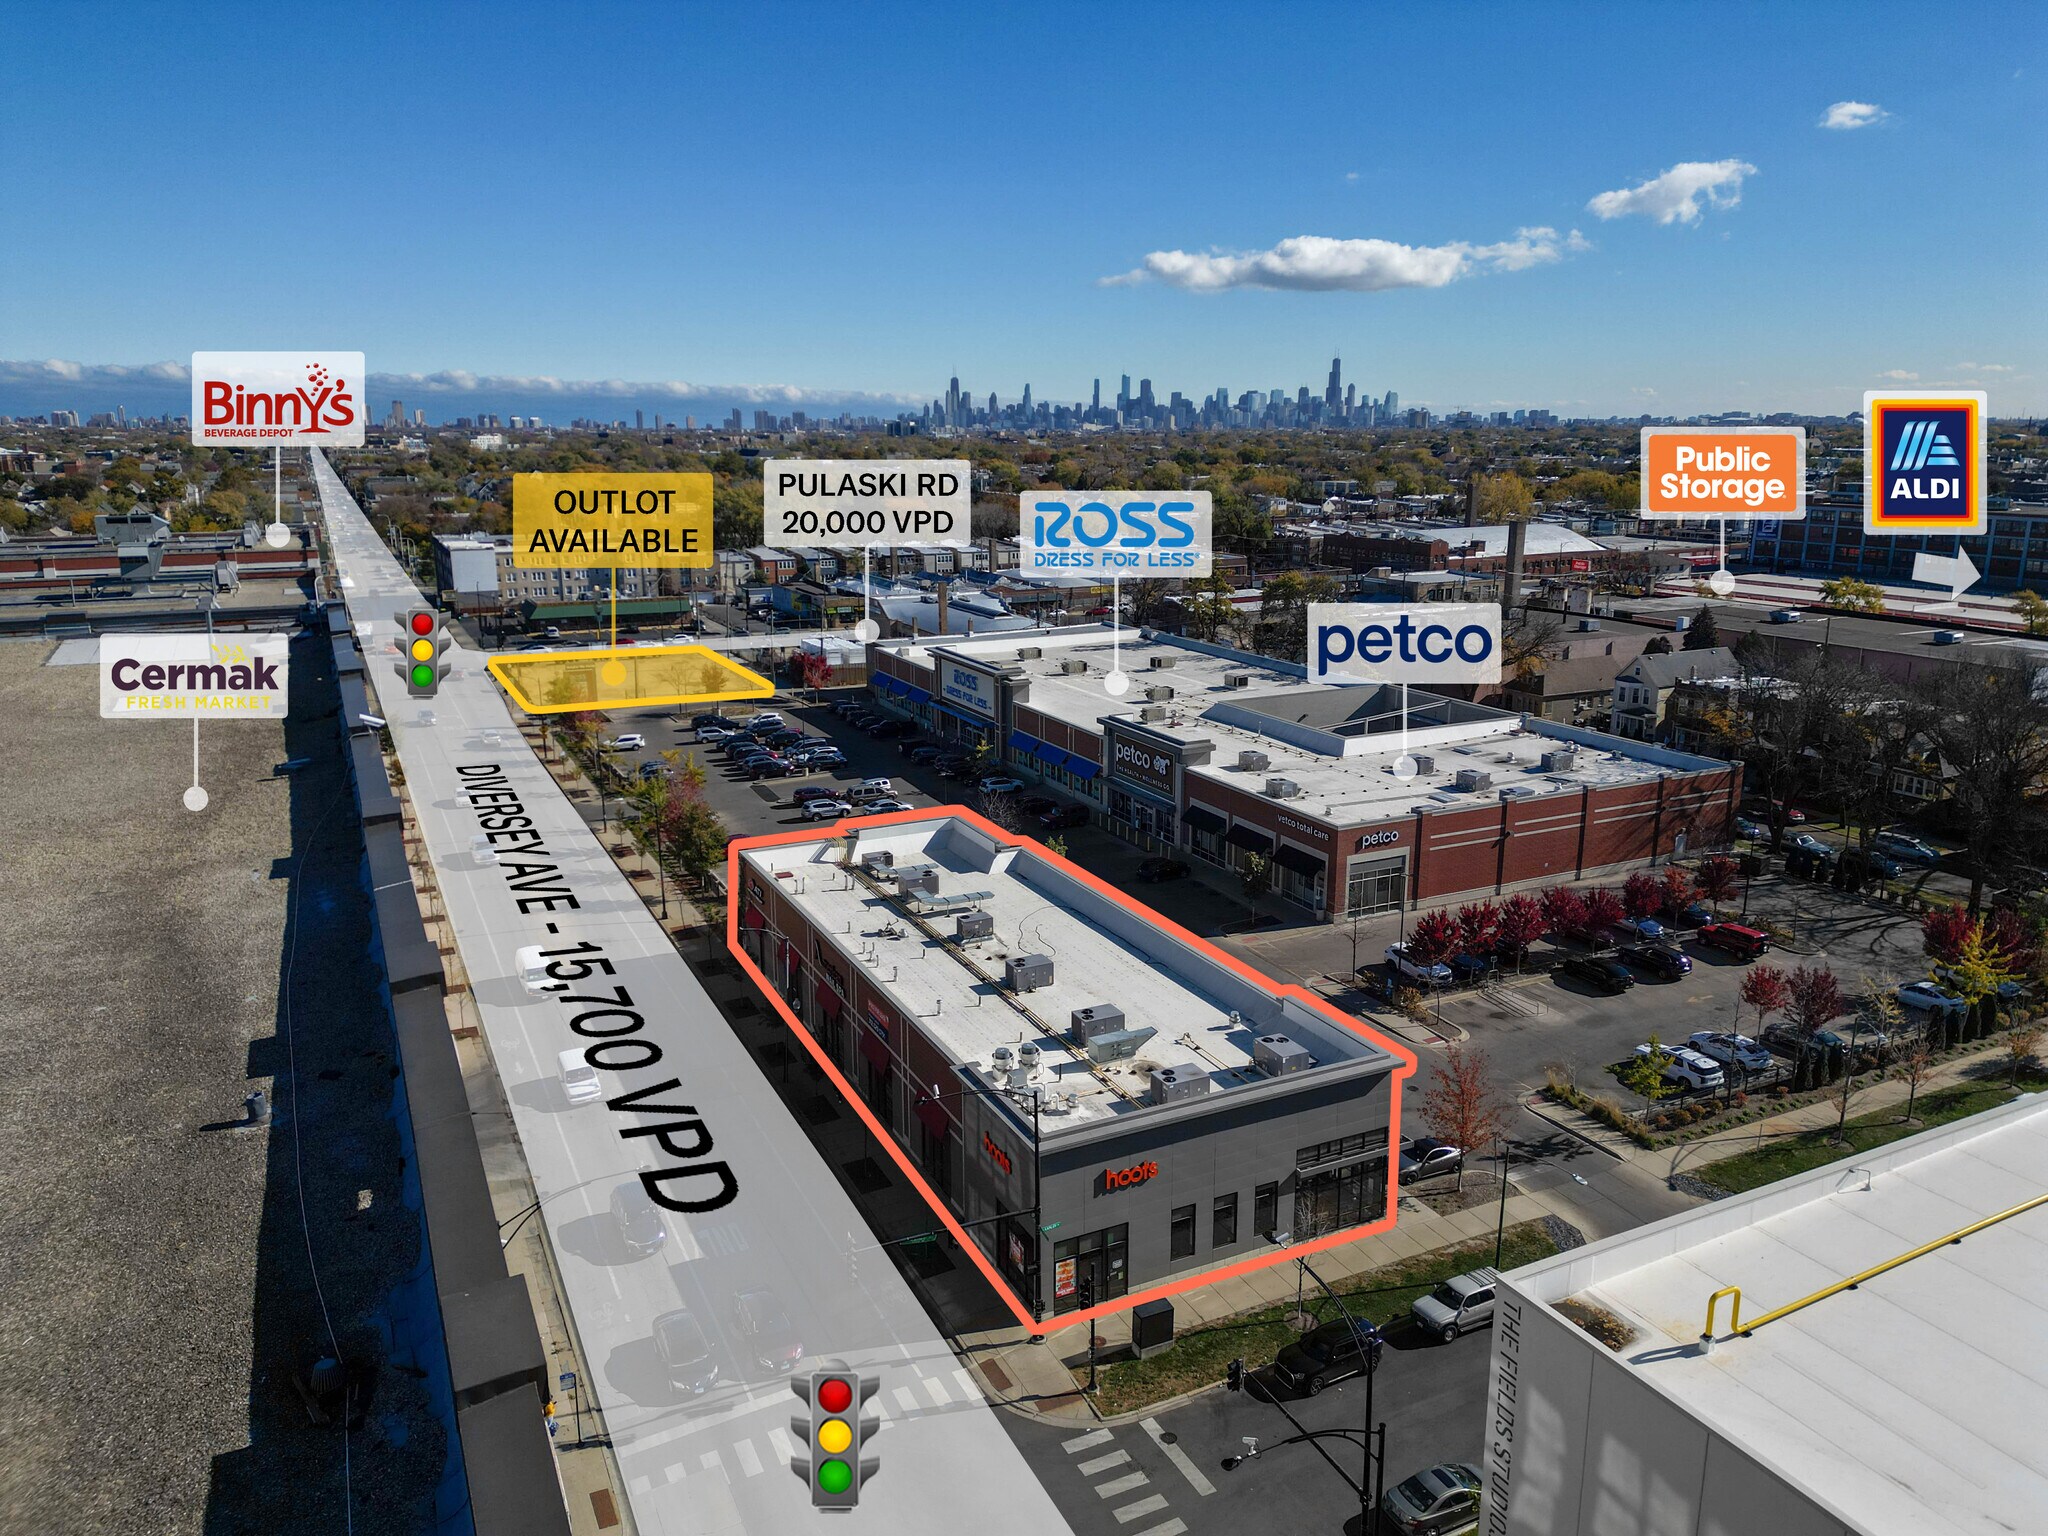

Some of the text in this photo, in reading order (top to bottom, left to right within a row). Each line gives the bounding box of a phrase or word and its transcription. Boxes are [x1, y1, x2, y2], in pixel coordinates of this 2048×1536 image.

[954, 669, 978, 691] ROSS
[963, 692, 973, 703] FOR
[974, 696, 987, 709] LESS
[1116, 742, 1151, 769] petco
[1277, 814, 1329, 841] vetco total care
[1362, 830, 1399, 849] petco
[983, 1130, 1011, 1176] hoots
[1105, 1160, 1159, 1190] hoots
[1488, 1301, 1522, 1536] THE FIELDS STUDIO
